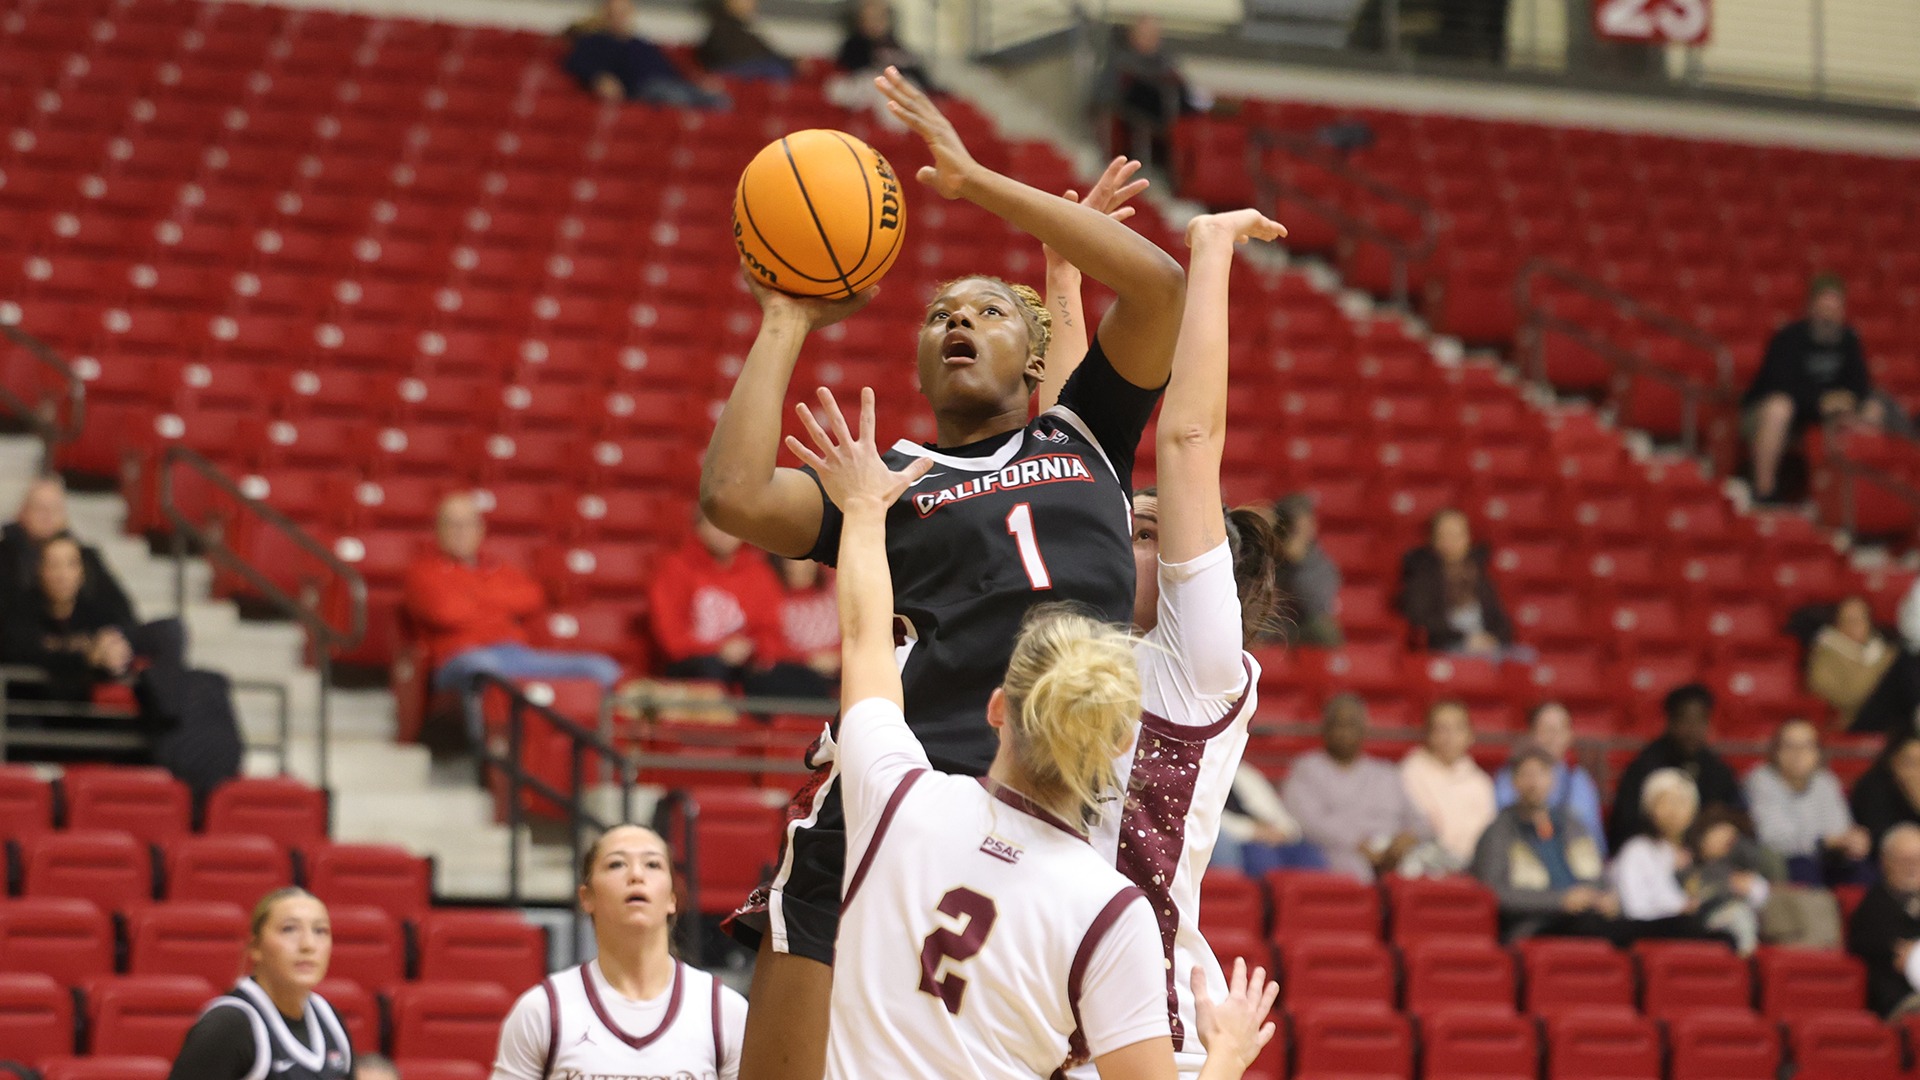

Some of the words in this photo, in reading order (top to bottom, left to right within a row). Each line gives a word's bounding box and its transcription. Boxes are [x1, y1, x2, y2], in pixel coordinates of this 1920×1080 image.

[914, 454, 1091, 517] CALIFORNIA
[1005, 502, 1052, 590] 1
[981, 835, 1025, 861] PSAC
[917, 885, 998, 1016] 2
